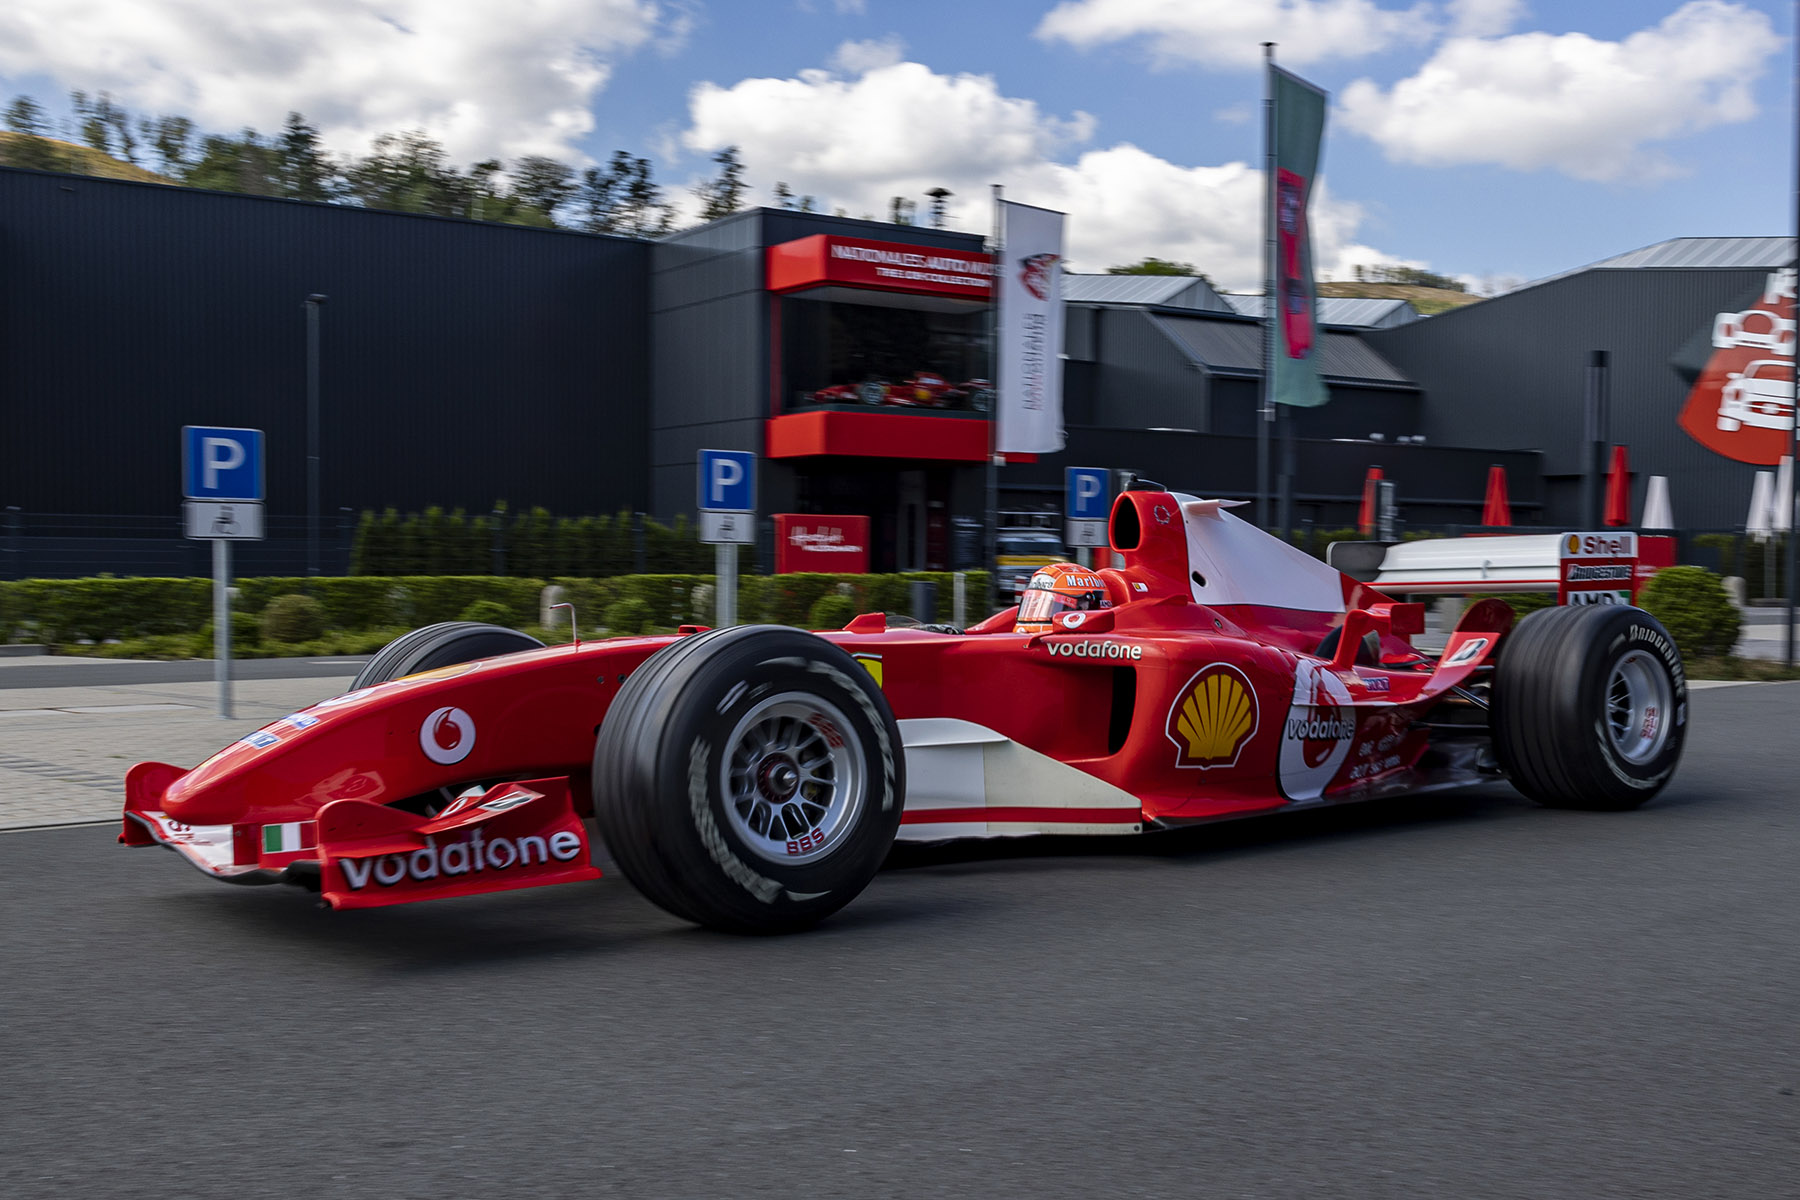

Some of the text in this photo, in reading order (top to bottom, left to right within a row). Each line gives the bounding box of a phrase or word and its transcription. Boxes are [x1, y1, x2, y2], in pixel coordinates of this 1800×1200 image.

[202, 437, 245, 489] P
[711, 458, 744, 502] P
[1076, 475, 1101, 511] P
[1584, 536, 1632, 554] Shell
[1046, 639, 1142, 660] vodafone
[1288, 714, 1355, 740] vodafone
[786, 827, 825, 855] BBS
[339, 828, 581, 889] vodafone
